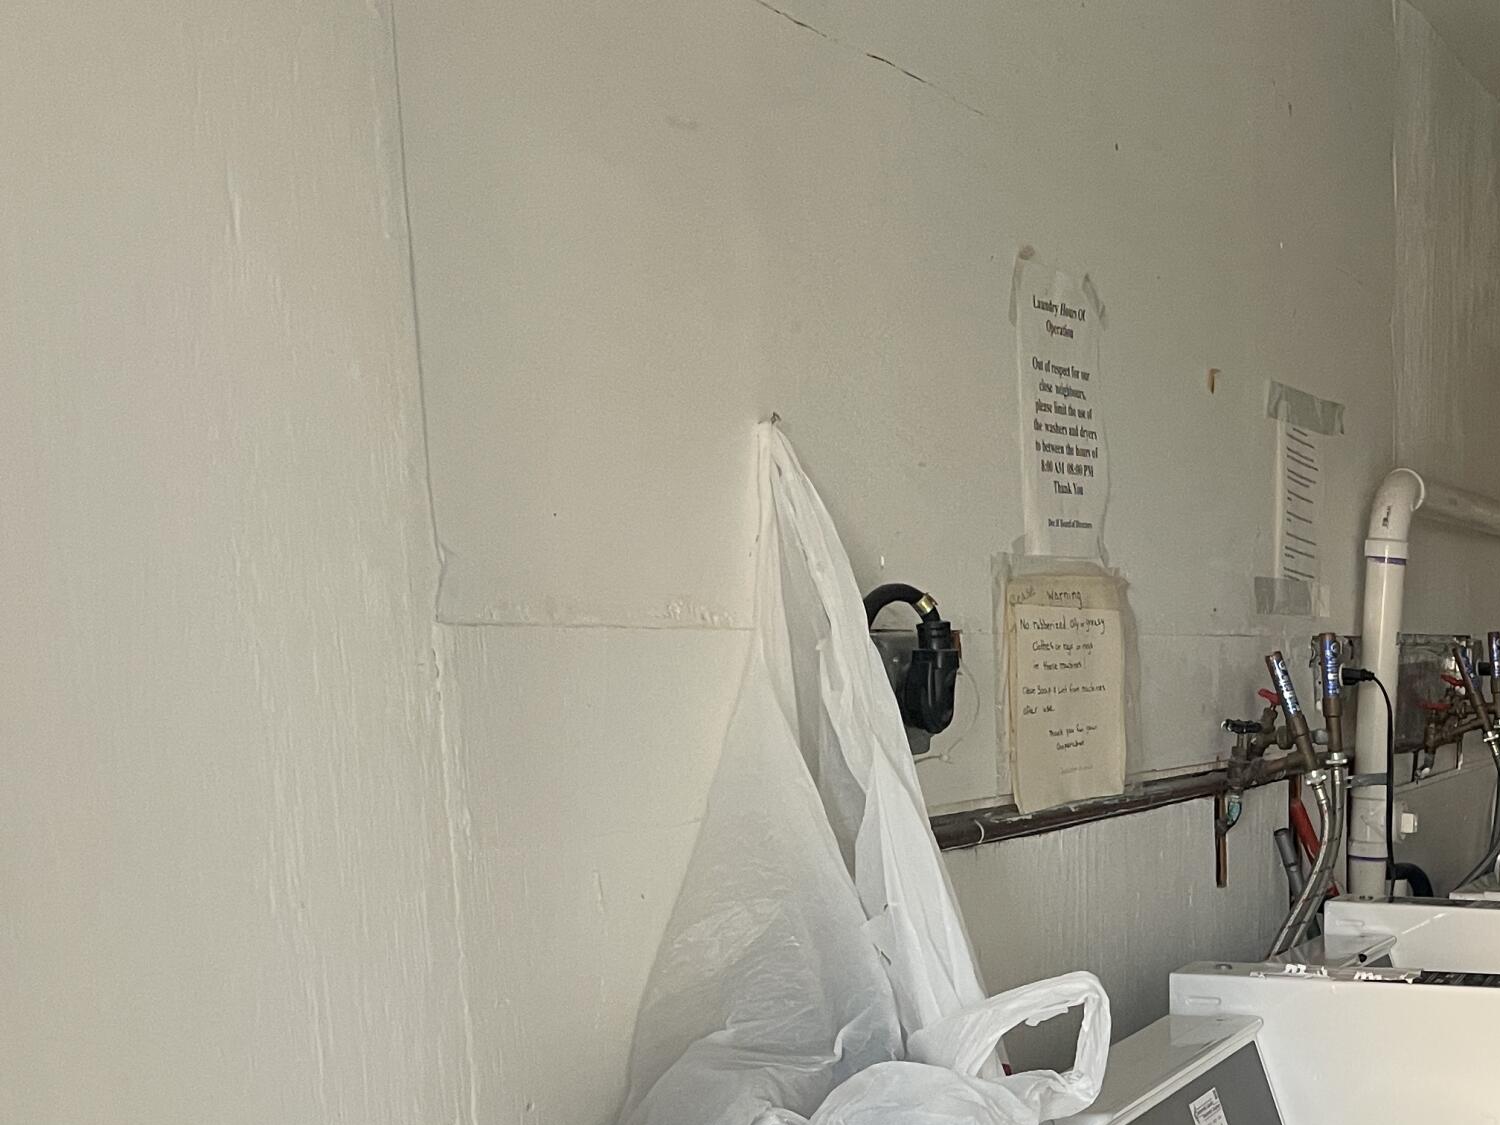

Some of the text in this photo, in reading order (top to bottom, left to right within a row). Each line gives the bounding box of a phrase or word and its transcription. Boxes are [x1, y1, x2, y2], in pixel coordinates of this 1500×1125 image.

[1032, 294, 1058, 317] Laundry
[1060, 303, 1077, 319] Hours
[1046, 319, 1073, 339] Operation
[1032, 356, 1044, 371] Out
[1044, 360, 1051, 373] of
[1051, 364, 1070, 379] respect
[1071, 365, 1080, 379] for
[1039, 378, 1053, 392] close
[1035, 398, 1092, 419] please limit the use of
[1034, 418, 1097, 441] the washers and dryers
[1035, 439, 1098, 458] to between the hours of
[1084, 465, 1094, 477] PM
[1054, 480, 1084, 495] Thank You
[1046, 588, 1083, 610] Warning
[1020, 618, 1029, 630] No
